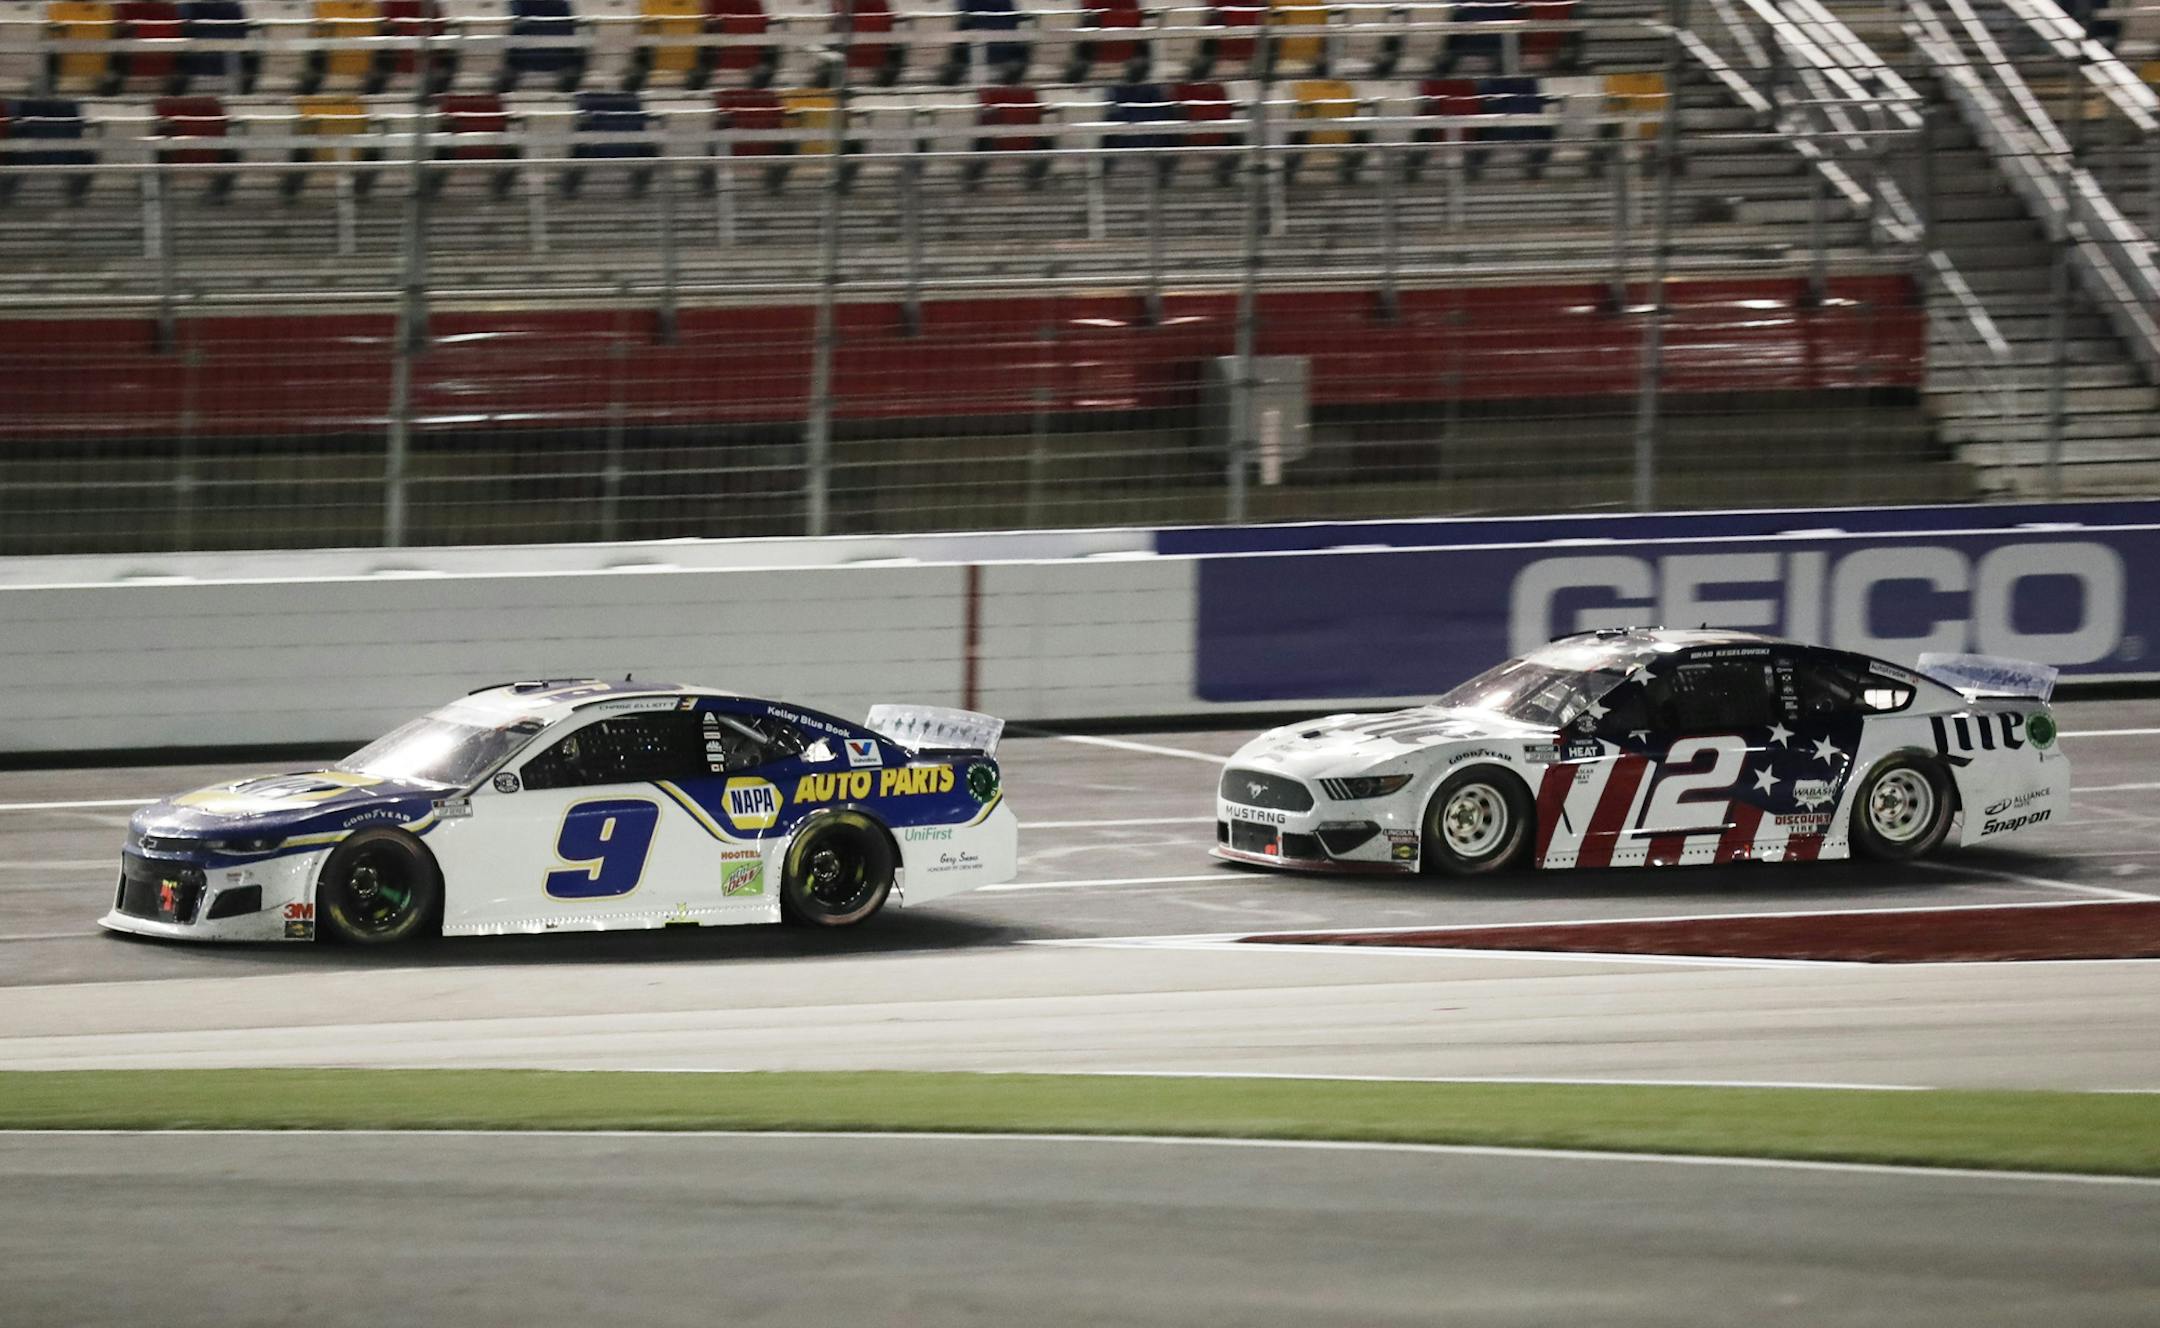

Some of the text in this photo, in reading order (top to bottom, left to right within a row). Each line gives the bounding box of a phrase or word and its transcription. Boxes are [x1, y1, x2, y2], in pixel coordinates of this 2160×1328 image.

[1509, 542, 2126, 666] GEICO
[767, 706, 851, 738] Kelley Blue Book
[1448, 748, 1513, 765] GOODYEAR
[1568, 746, 1598, 757] HEAT
[793, 772, 873, 804] AUTO
[879, 764, 955, 797] PARTS
[1641, 735, 1748, 830] 2
[730, 787, 775, 815] NAPA
[2014, 787, 2051, 803] ALLIANCE
[342, 808, 412, 828] GOODYEAR
[1226, 804, 1287, 824] MUSTANG
[904, 827, 953, 842] UniFirst
[546, 798, 661, 898] 9
[283, 903, 314, 919] 3M
